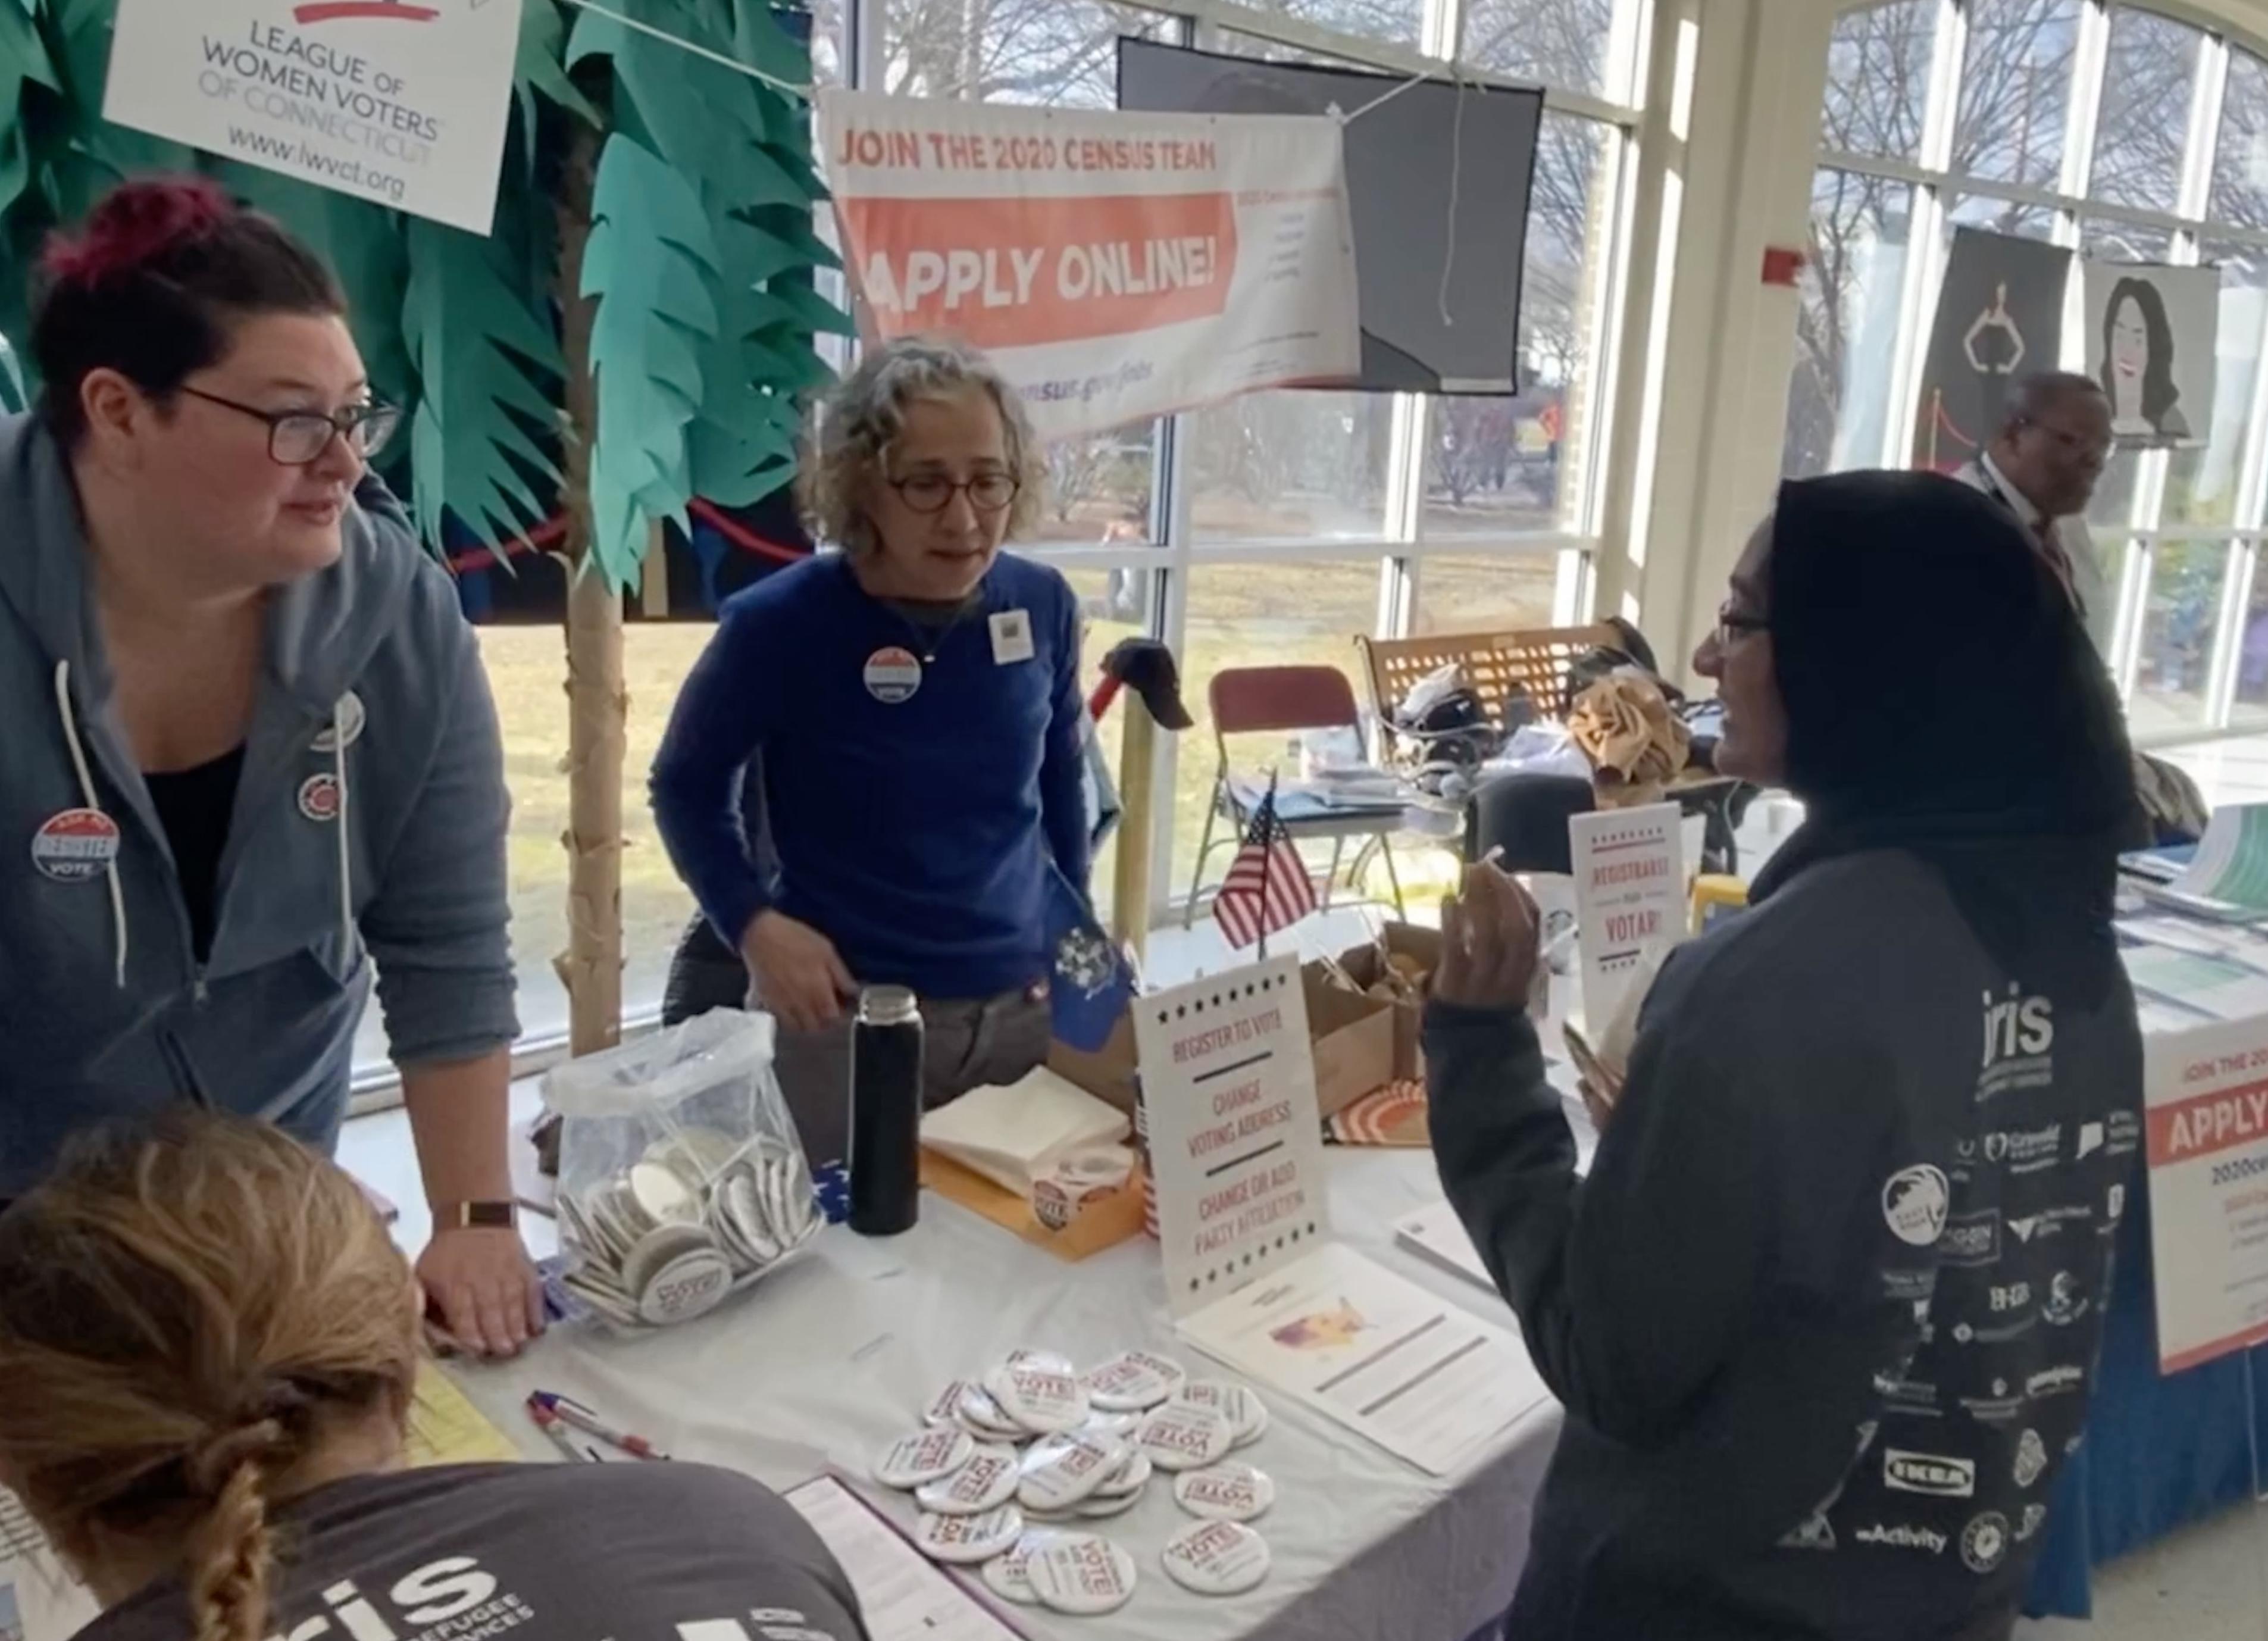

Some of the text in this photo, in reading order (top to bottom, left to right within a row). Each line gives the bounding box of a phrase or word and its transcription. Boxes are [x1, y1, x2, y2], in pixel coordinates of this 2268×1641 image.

[250, 20, 405, 97] LEAGUE OF
[200, 35, 439, 143] WOMEN VOTERS
[198, 69, 431, 167] OF CONNECTICUT
[836, 129, 1216, 171] JOIN THE 2020 CENSUS TEAM
[864, 247, 1044, 314] APPLY
[1056, 236, 1217, 300] ONLINE!
[1174, 1024, 1234, 1064] REGISTER
[1252, 1008, 1282, 1036] VOTE
[1212, 1078, 1261, 1117] CHANGE
[2167, 1089, 2268, 1155] APPLY
[1187, 1099, 1291, 1159] VOTING ADDRESS
[1199, 1178, 1250, 1221] CHANGE
[1195, 1219, 1235, 1256] PARTY
[1893, 1461, 1966, 1487] IKEA
[1081, 1540, 1115, 1596] VOTE!
